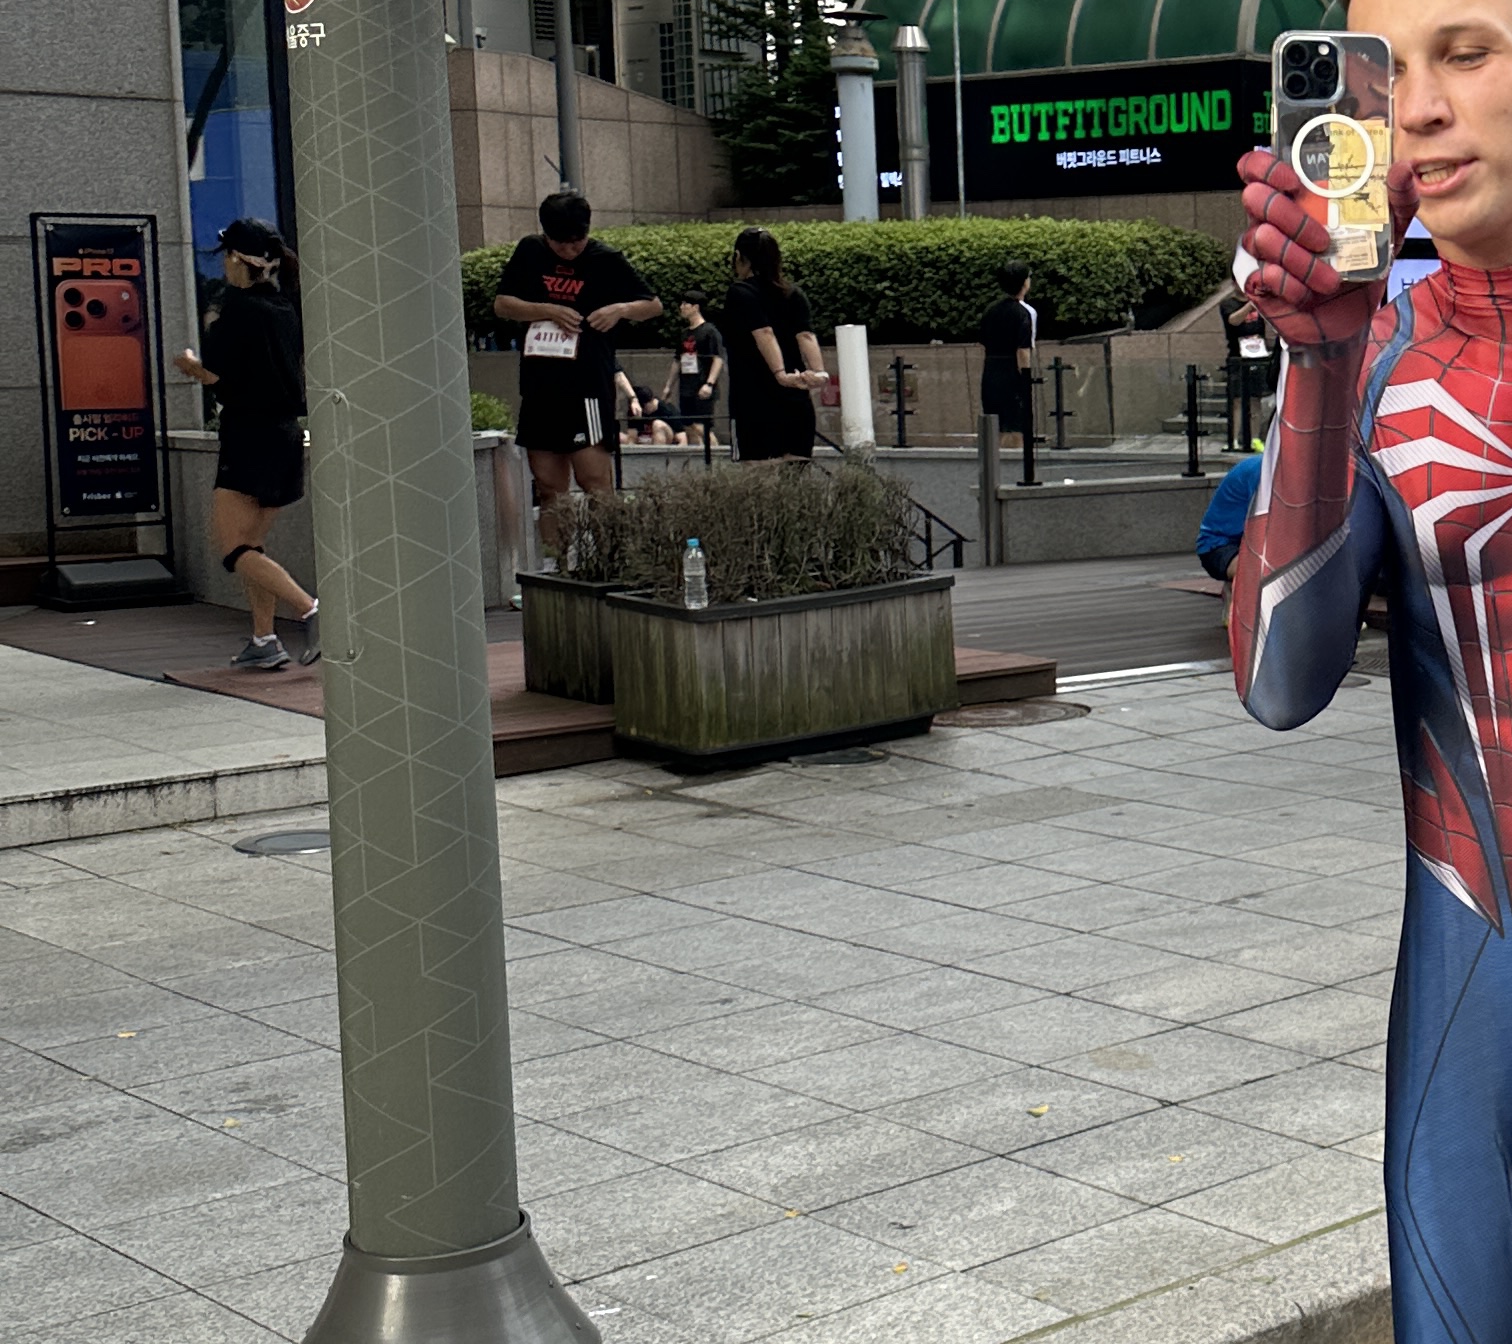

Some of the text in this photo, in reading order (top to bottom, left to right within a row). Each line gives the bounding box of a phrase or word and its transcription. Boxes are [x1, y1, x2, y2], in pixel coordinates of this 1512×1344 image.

[990, 89, 1233, 144] BUTFITGROUND
[1056, 147, 1162, 169] 버핏그라운드 피트니스
[53, 257, 141, 276] PRO
[542, 275, 585, 295] RUN
[68, 426, 109, 443] PICK
[121, 425, 145, 440] UP
